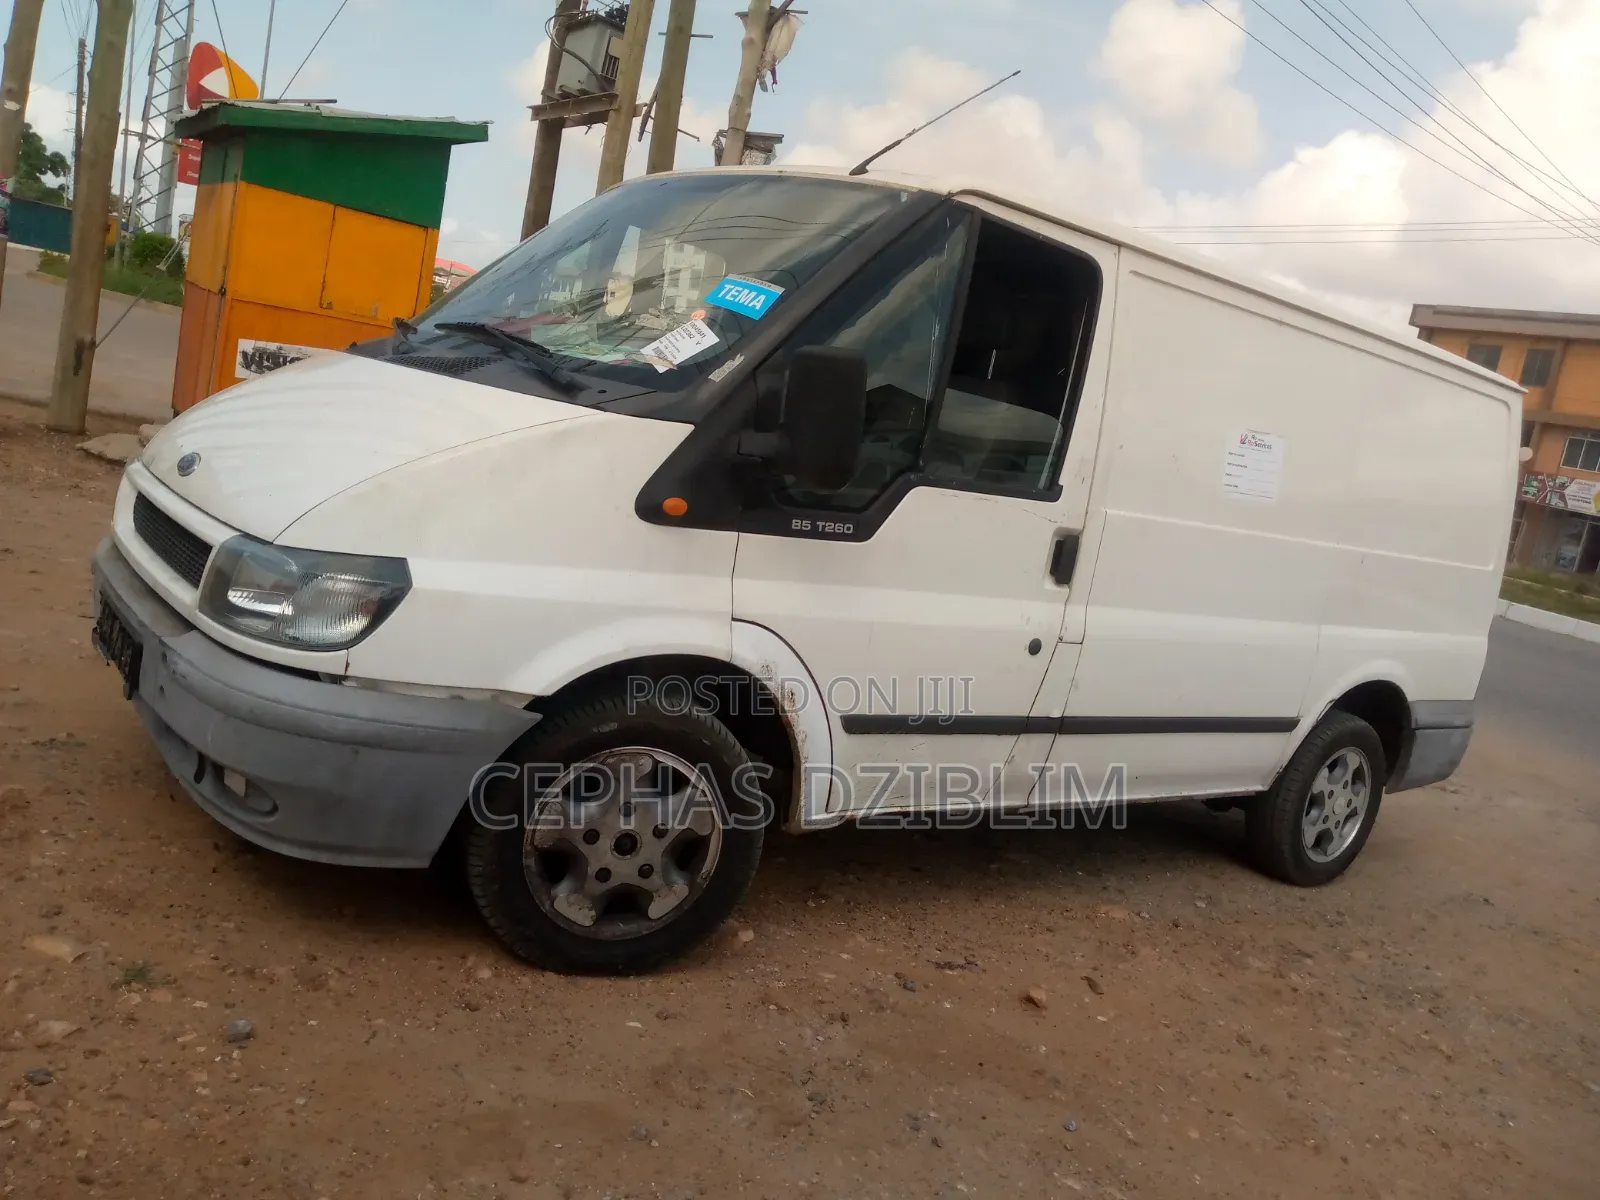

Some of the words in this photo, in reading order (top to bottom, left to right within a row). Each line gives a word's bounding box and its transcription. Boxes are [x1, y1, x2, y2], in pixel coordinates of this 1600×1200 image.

[717, 284, 766, 310] TEMA
[791, 519, 811, 531] 85
[816, 521, 854, 534] T260
